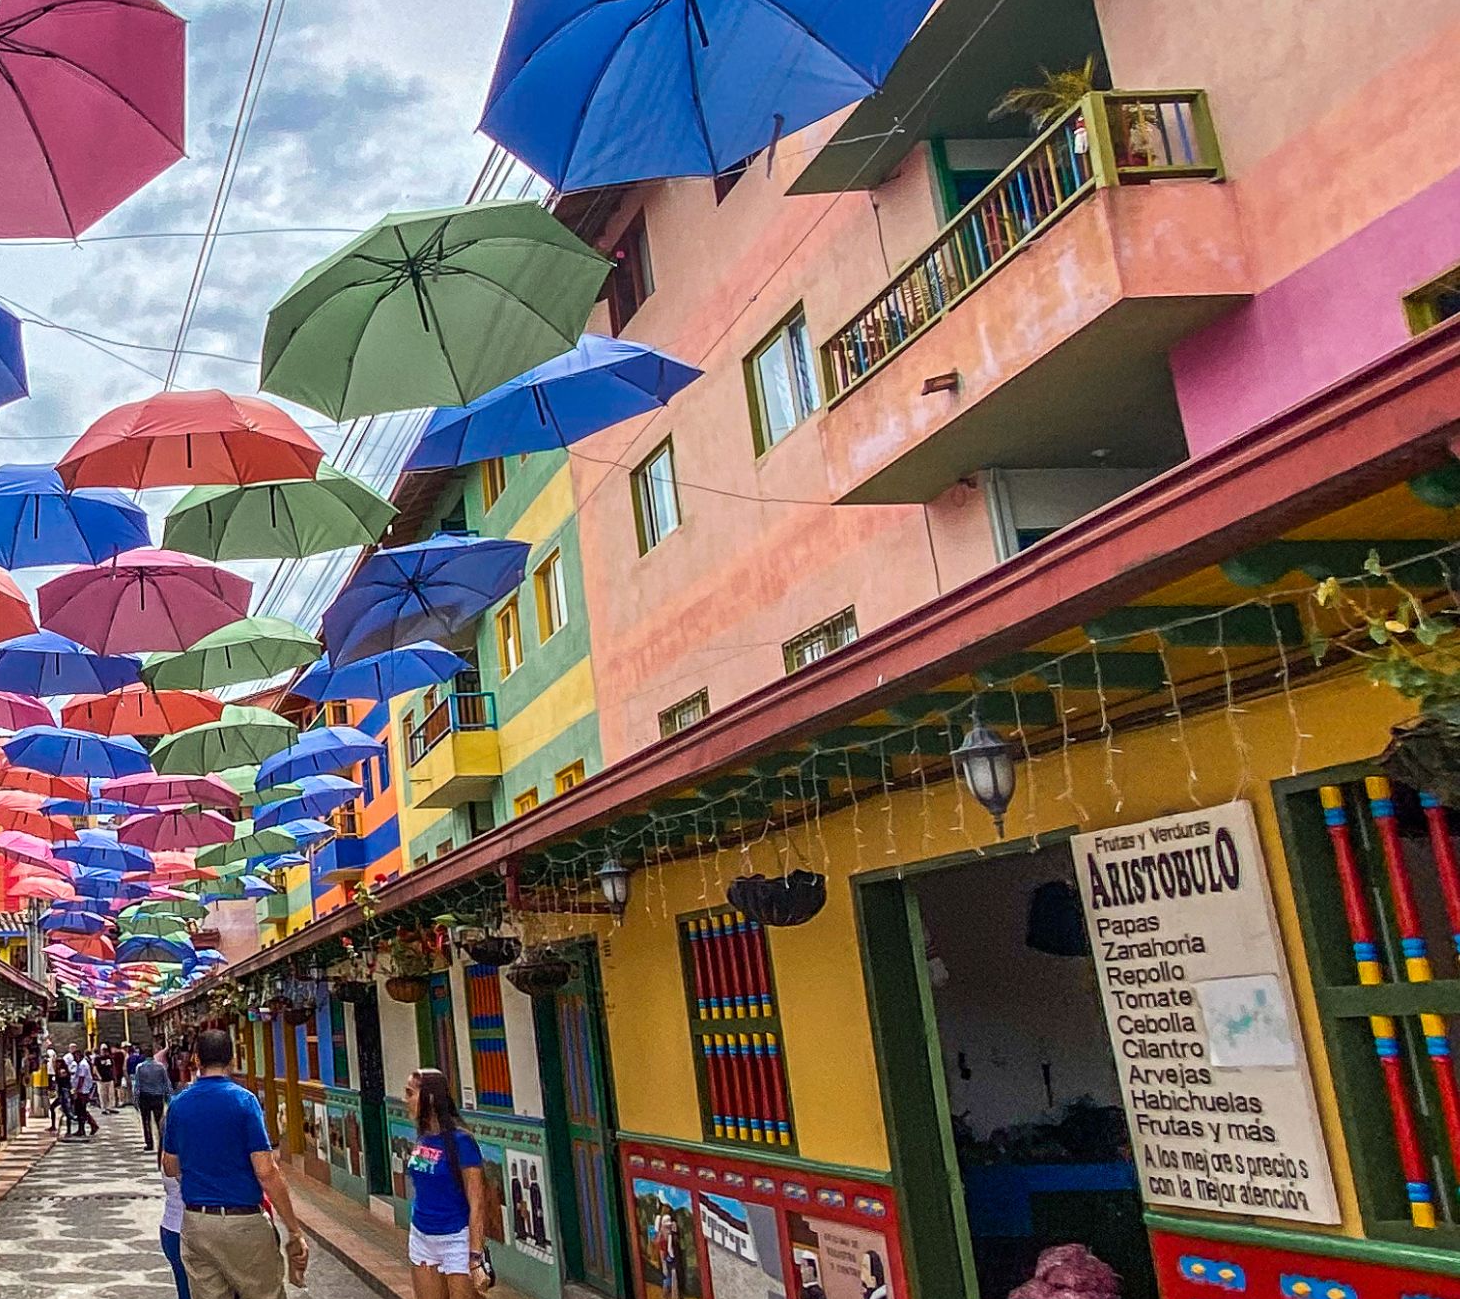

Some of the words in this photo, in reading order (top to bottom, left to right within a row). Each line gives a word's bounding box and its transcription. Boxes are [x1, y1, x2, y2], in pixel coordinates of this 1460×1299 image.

[1094, 834, 1136, 853] Frutas
[1137, 832, 1146, 850] y
[1148, 820, 1211, 845] Verduras
[1087, 827, 1240, 910] ARISTOBULO
[1096, 915, 1160, 939] Papas
[1101, 933, 1206, 962] Zanahoria
[1106, 960, 1185, 989] Repollo
[1111, 987, 1192, 1010] Tomate
[1117, 1012, 1197, 1035] Cebolla
[1122, 1038, 1204, 1059] Cilantro
[1129, 1063, 1212, 1089] Arvejas
[1130, 1089, 1263, 1114] Habichuelas
[1136, 1113, 1205, 1138] Frutas
[1207, 1121, 1221, 1143] y
[1227, 1117, 1276, 1143] más
[1144, 1144, 1156, 1169] A
[1156, 1144, 1179, 1170] los
[1247, 1152, 1310, 1181] precios
[1148, 1175, 1176, 1198] con
[1177, 1174, 1193, 1200] la
[1195, 1177, 1237, 1208] mejor
[1239, 1181, 1311, 1212] atención
